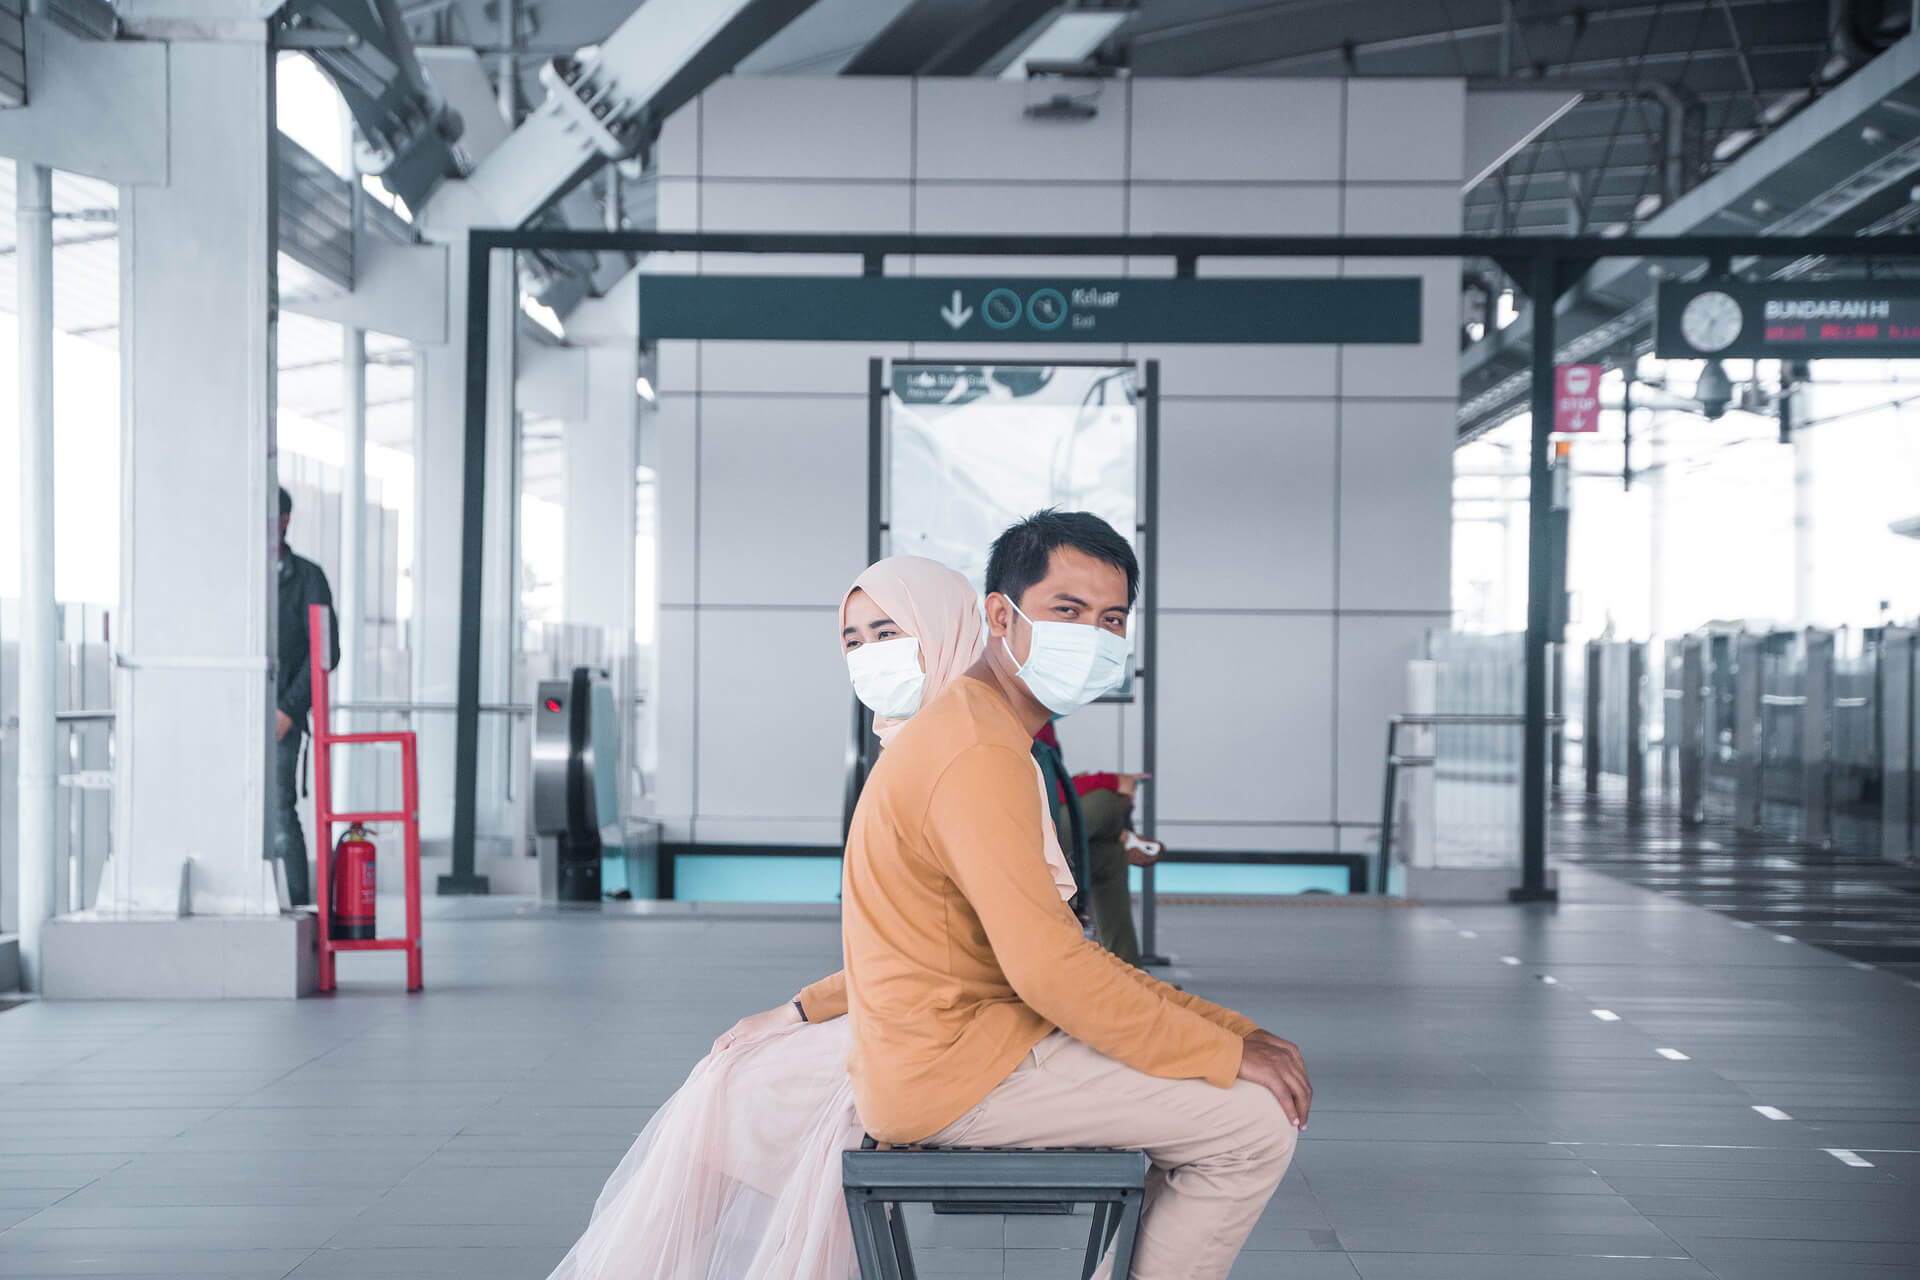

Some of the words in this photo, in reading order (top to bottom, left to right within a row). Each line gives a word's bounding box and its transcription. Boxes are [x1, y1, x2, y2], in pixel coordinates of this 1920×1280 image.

[1072, 288, 1120, 307] Keluar
[1765, 300, 1867, 319] BUNDARAN
[1870, 300, 1889, 318] HI
[1560, 397, 1596, 411] STOP
